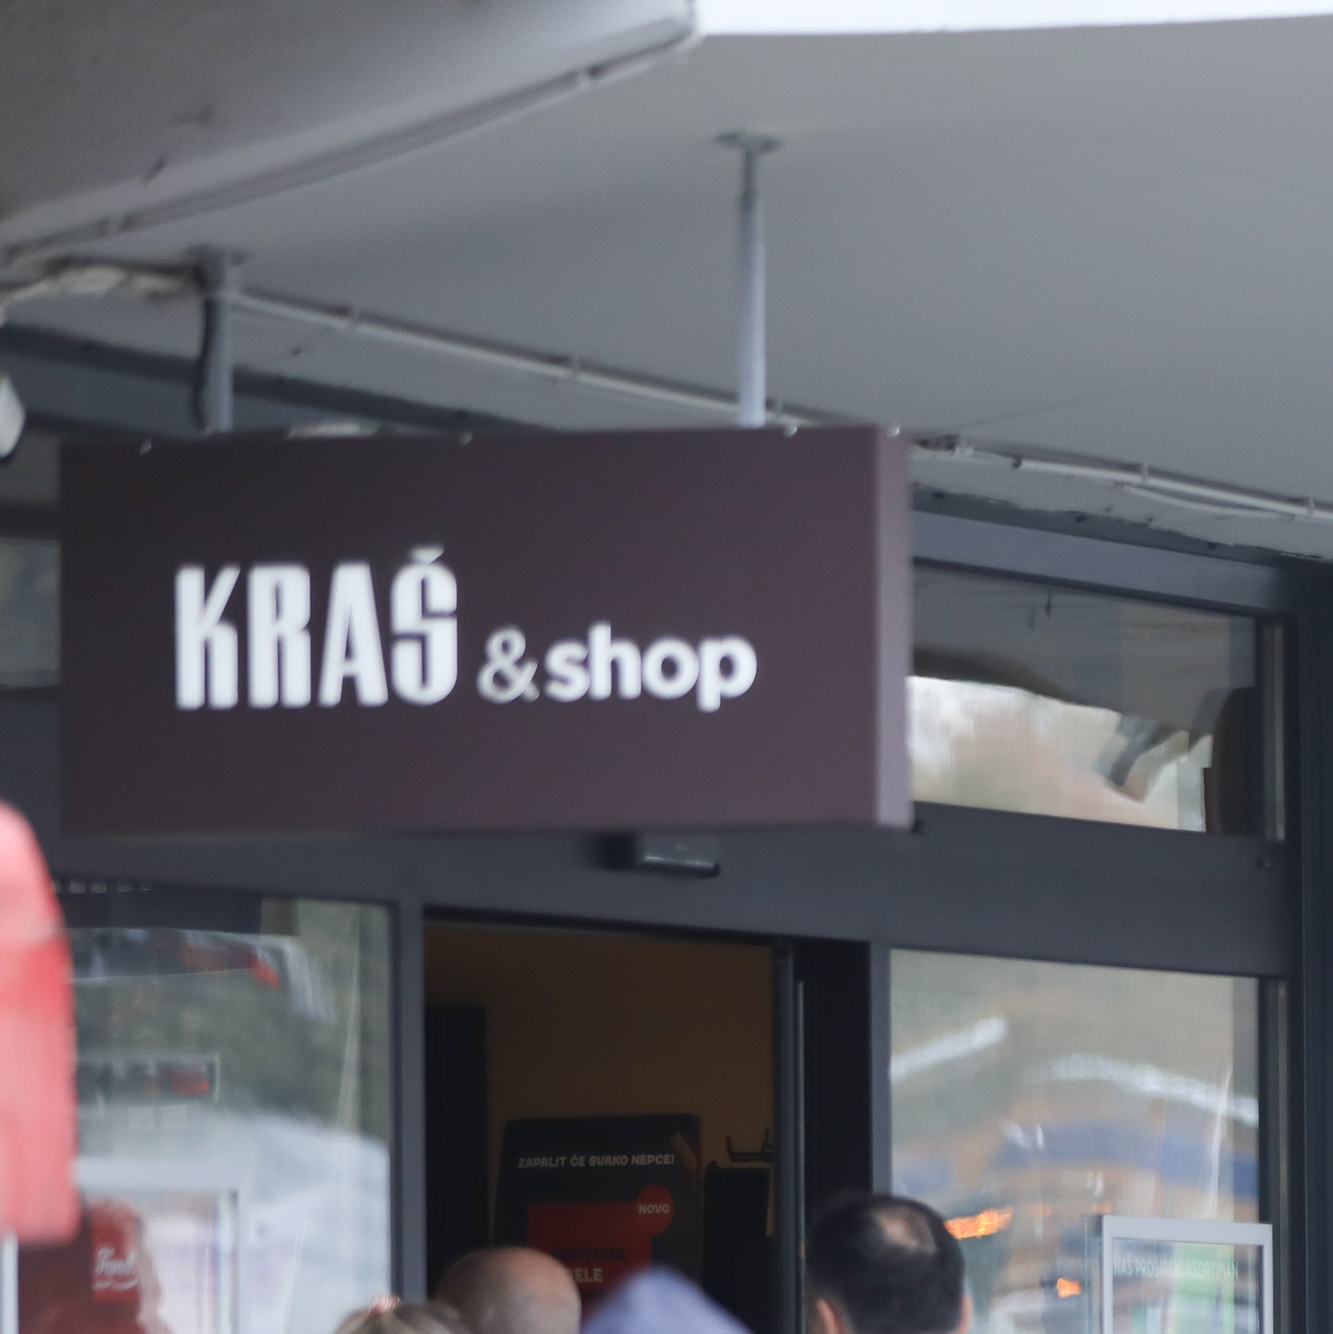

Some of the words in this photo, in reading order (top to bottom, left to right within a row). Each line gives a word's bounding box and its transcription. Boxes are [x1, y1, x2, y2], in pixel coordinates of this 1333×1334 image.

[174, 543, 458, 711] KRAŠ
[518, 1156, 566, 1169] ZAPALIT
[589, 1156, 629, 1167] SVAKO
[638, 1203, 670, 1215] NOVO
[568, 1267, 604, 1283] ELE
